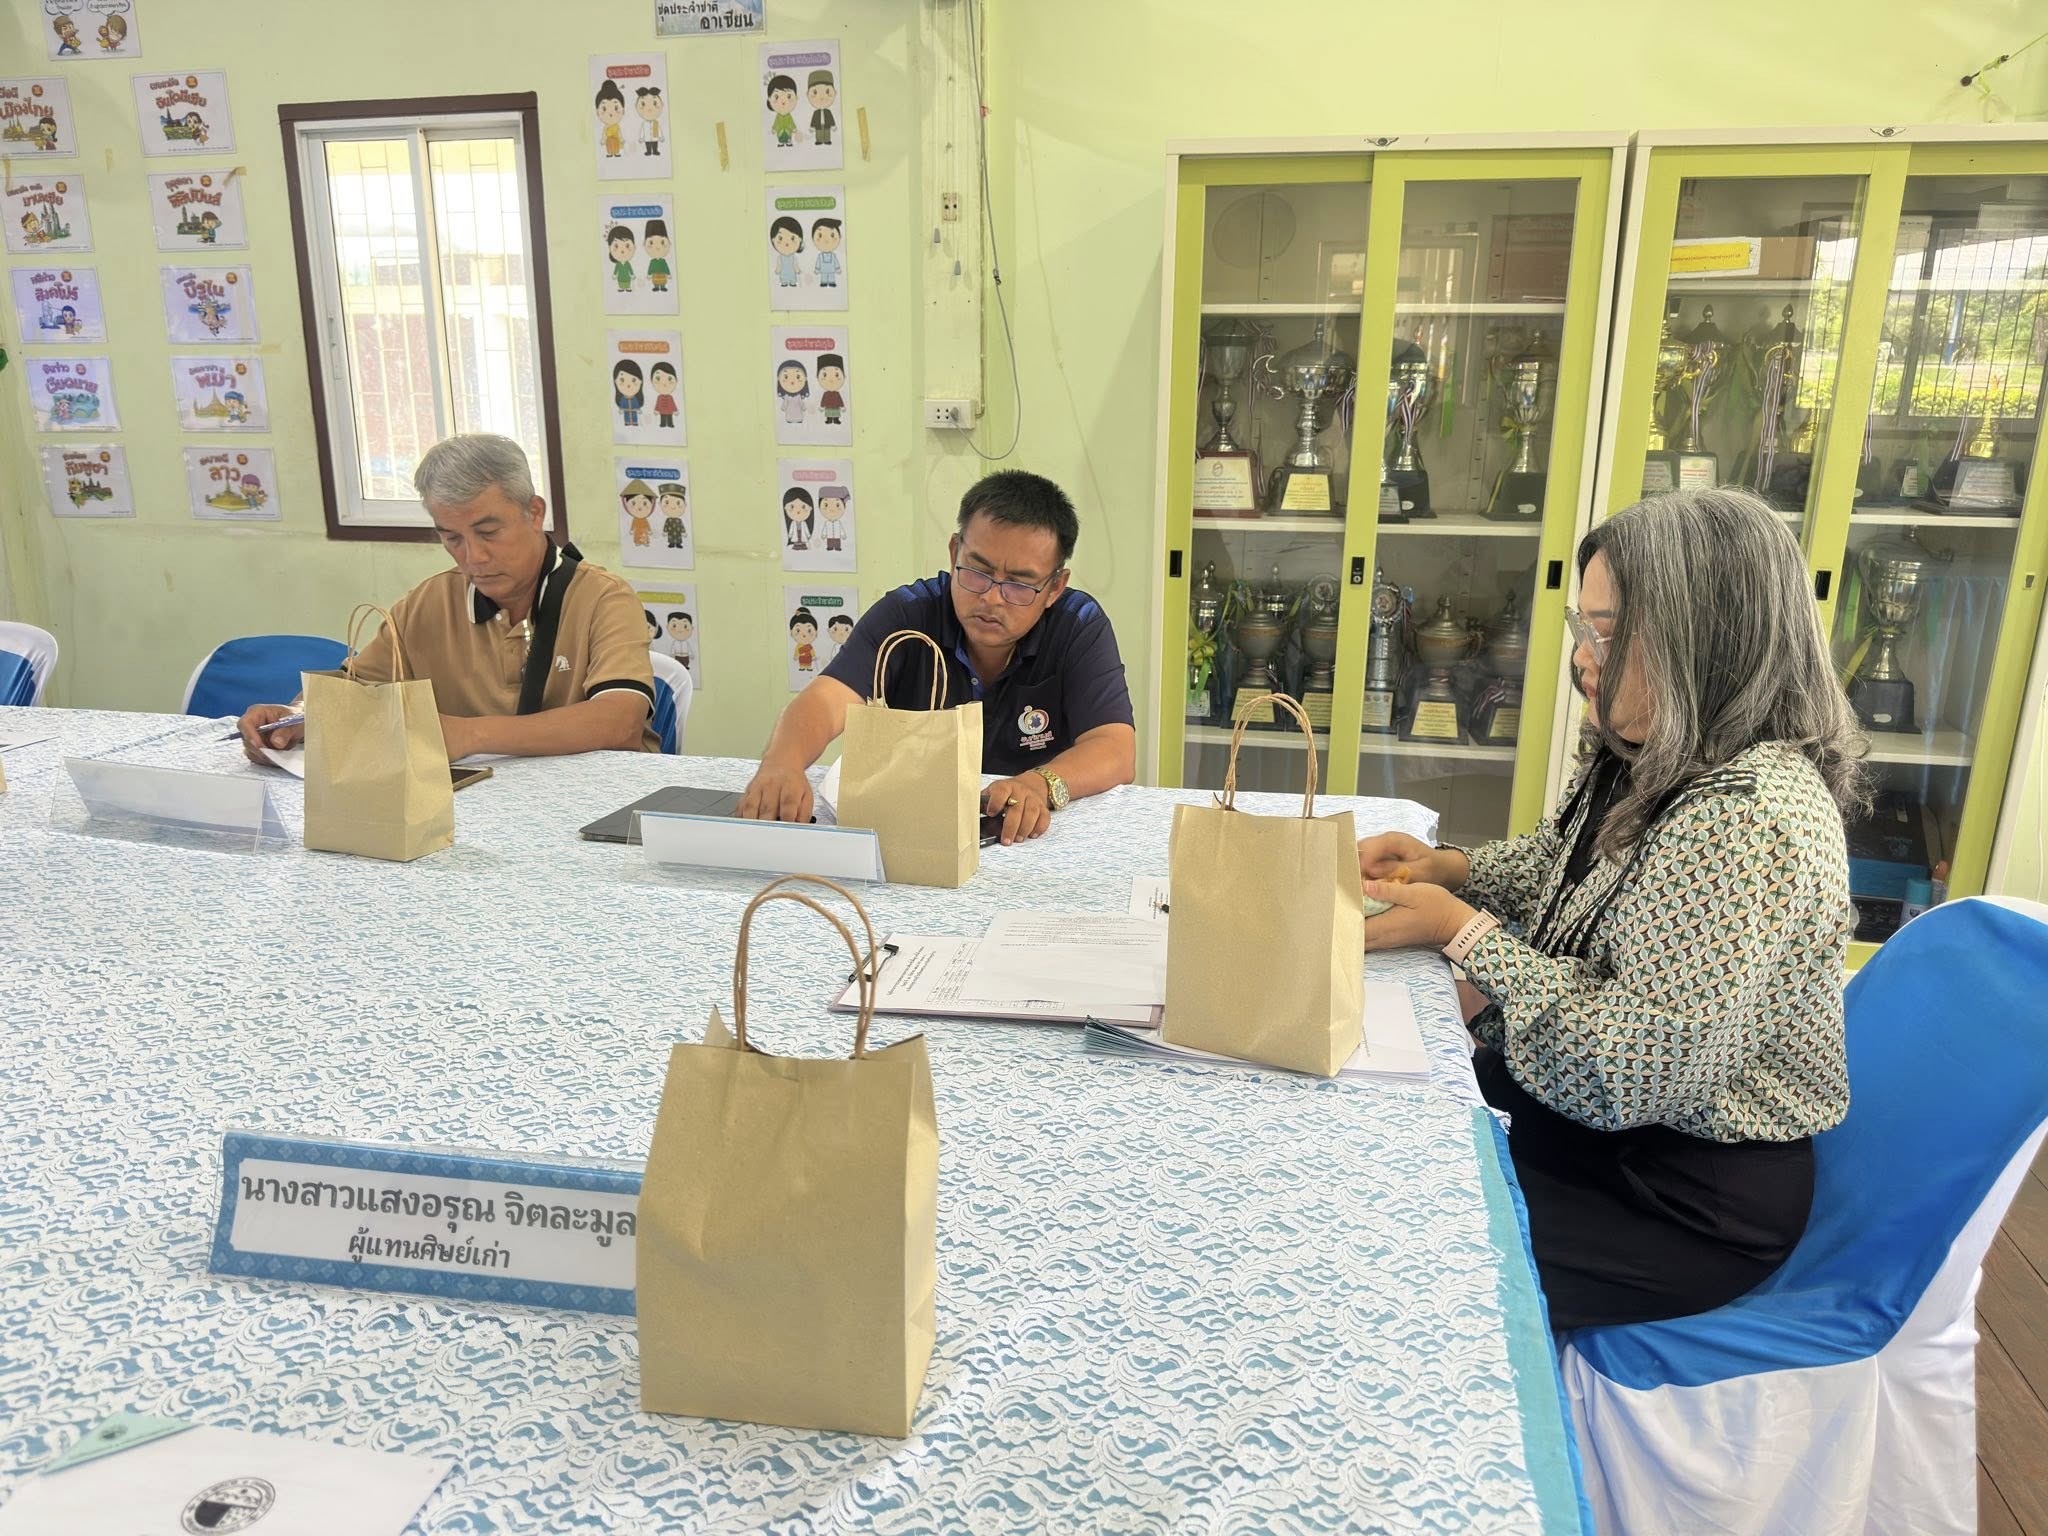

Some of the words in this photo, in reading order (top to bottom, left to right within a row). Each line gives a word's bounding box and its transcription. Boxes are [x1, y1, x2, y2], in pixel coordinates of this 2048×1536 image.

[658, 0, 719, 22] ชุดประจำชาติ
[701, 10, 754, 29] อาเซียน
[208, 464, 241, 481] ลาว
[241, 1172, 496, 1233] นางสาวแสงอรุณ
[504, 1190, 637, 1247] จิตละมูล
[347, 1227, 512, 1269] ผู้แทนศิษย์เก่า
